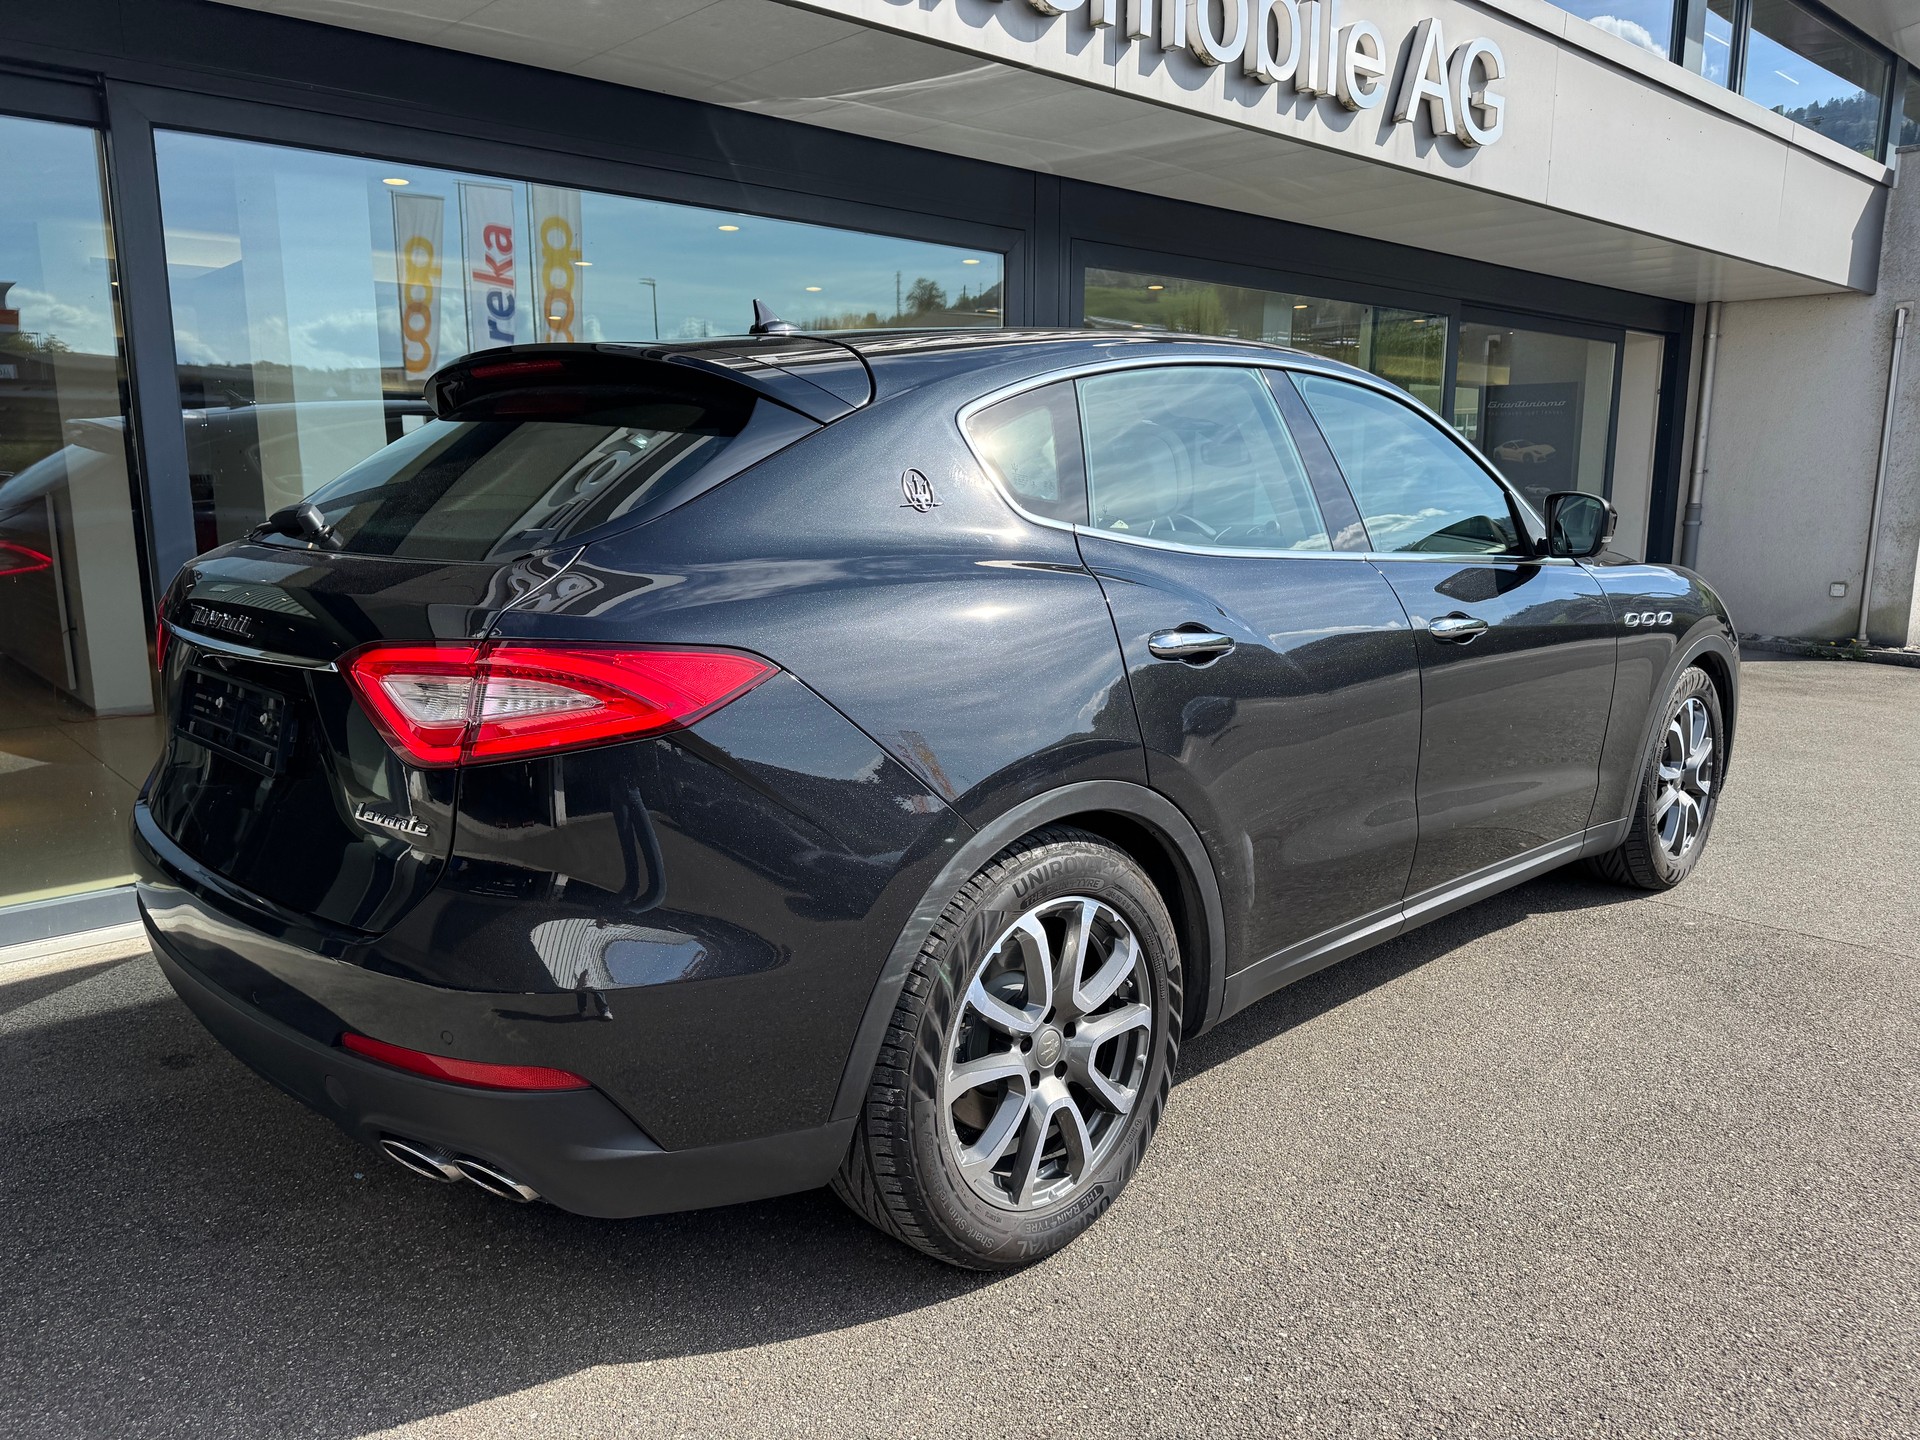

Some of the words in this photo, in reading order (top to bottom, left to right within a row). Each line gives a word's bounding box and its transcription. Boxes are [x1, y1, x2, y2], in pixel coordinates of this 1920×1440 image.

[1393, 17, 1505, 148] AG
[472, 223, 516, 344] reka
[404, 235, 442, 373] coop
[355, 802, 429, 837] Levante
[1077, 879, 1100, 888] TYRE
[1081, 1188, 1101, 1206] THE
[947, 1205, 967, 1231] Skin
[1056, 1206, 1081, 1224] RAIN
[966, 1228, 994, 1248] Shark
[1025, 1221, 1050, 1234] TYRE
